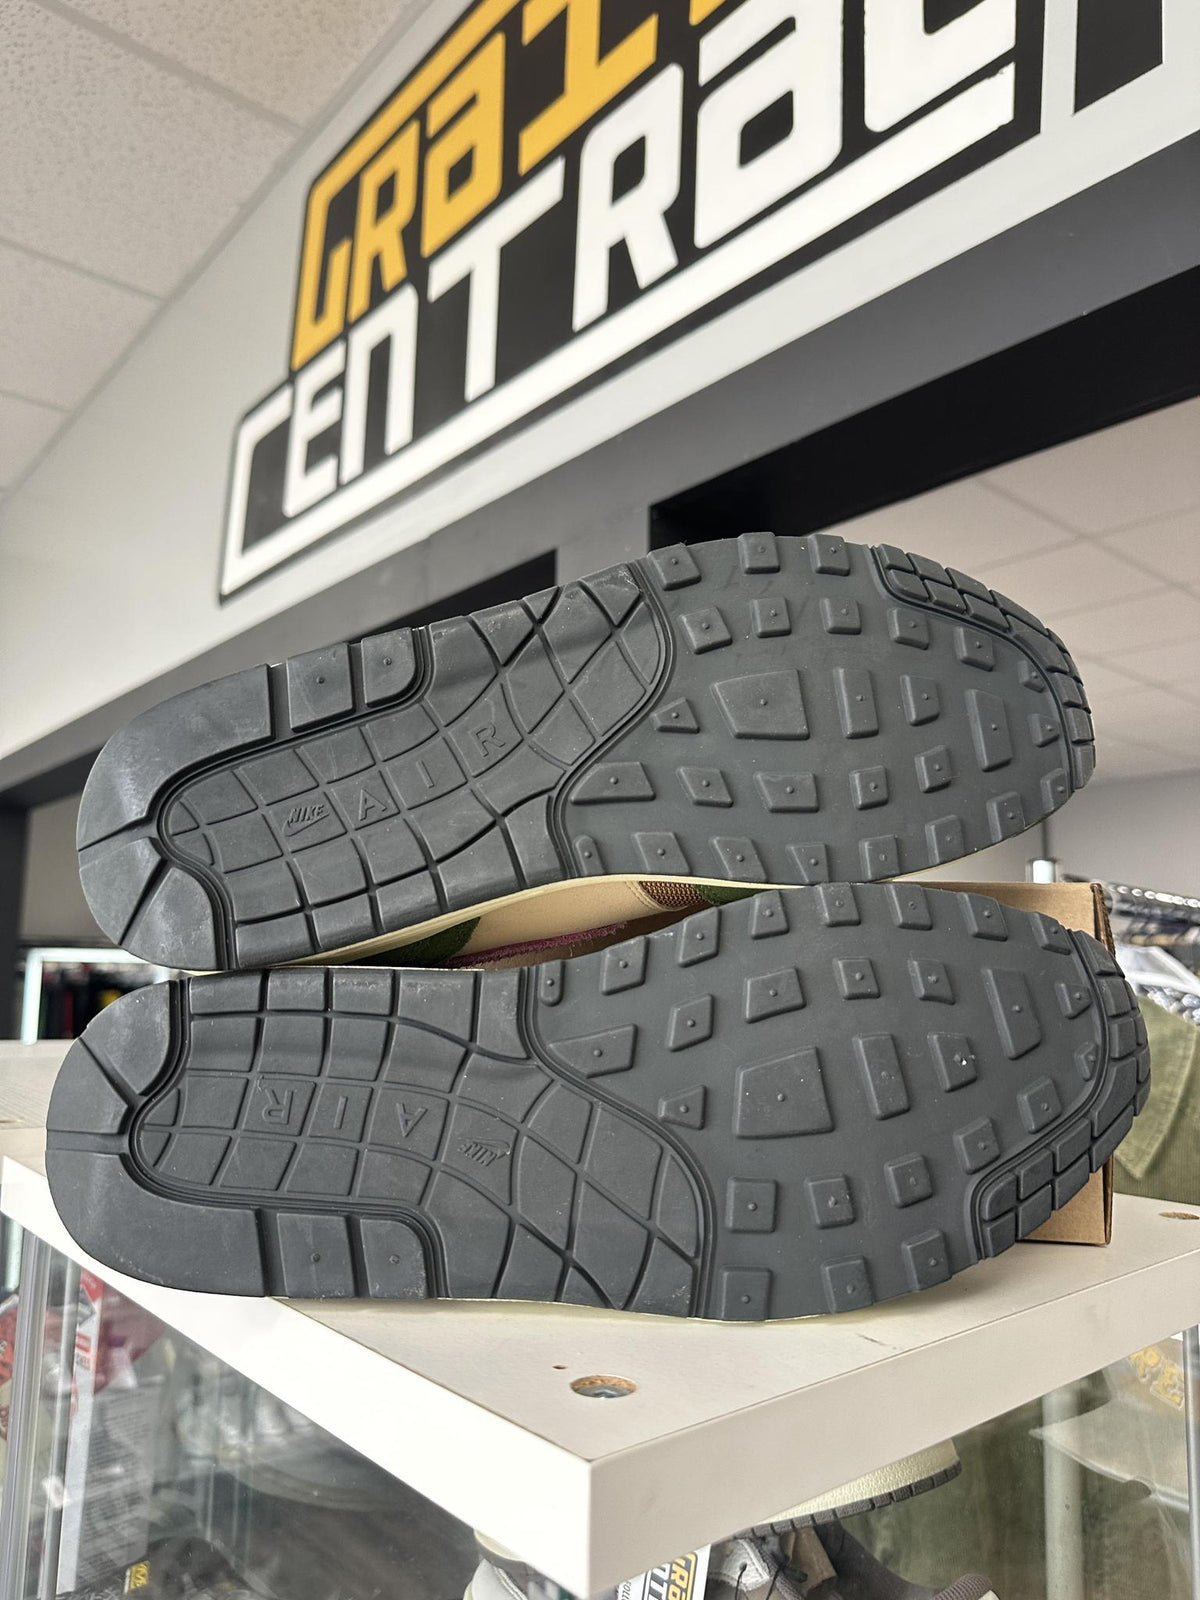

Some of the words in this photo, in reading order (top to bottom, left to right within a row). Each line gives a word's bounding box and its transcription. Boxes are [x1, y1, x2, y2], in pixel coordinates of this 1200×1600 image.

[358, 723, 505, 821] AIR
[287, 804, 326, 826] NIKE
[261, 1089, 428, 1138] AIR
